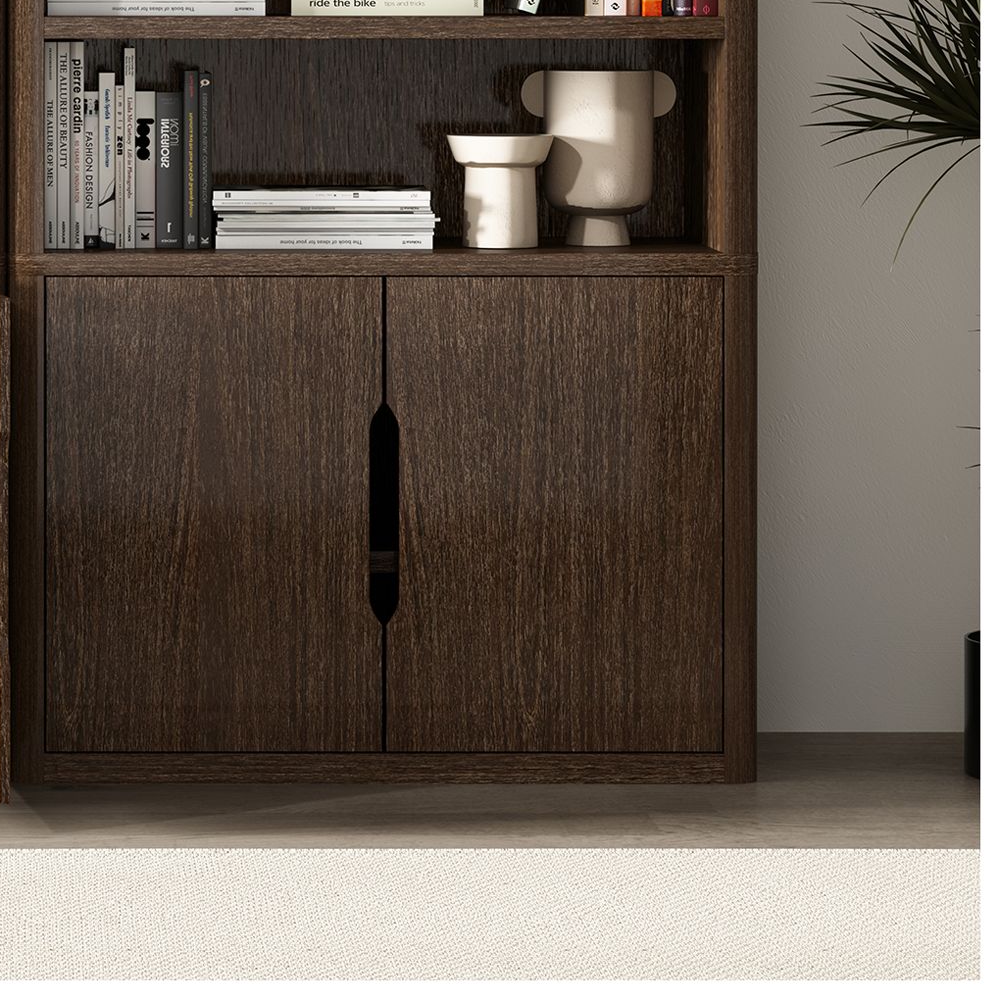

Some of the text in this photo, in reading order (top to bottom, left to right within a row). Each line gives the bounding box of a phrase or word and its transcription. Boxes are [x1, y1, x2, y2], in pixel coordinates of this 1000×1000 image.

[309, 0, 376, 7] ride the bike
[59, 52, 68, 170] THE ALLURE OF BEAUTY
[71, 58, 84, 134] pierre cardin
[47, 150, 54, 162] OF
[85, 131, 94, 209] FASHION DESIGN
